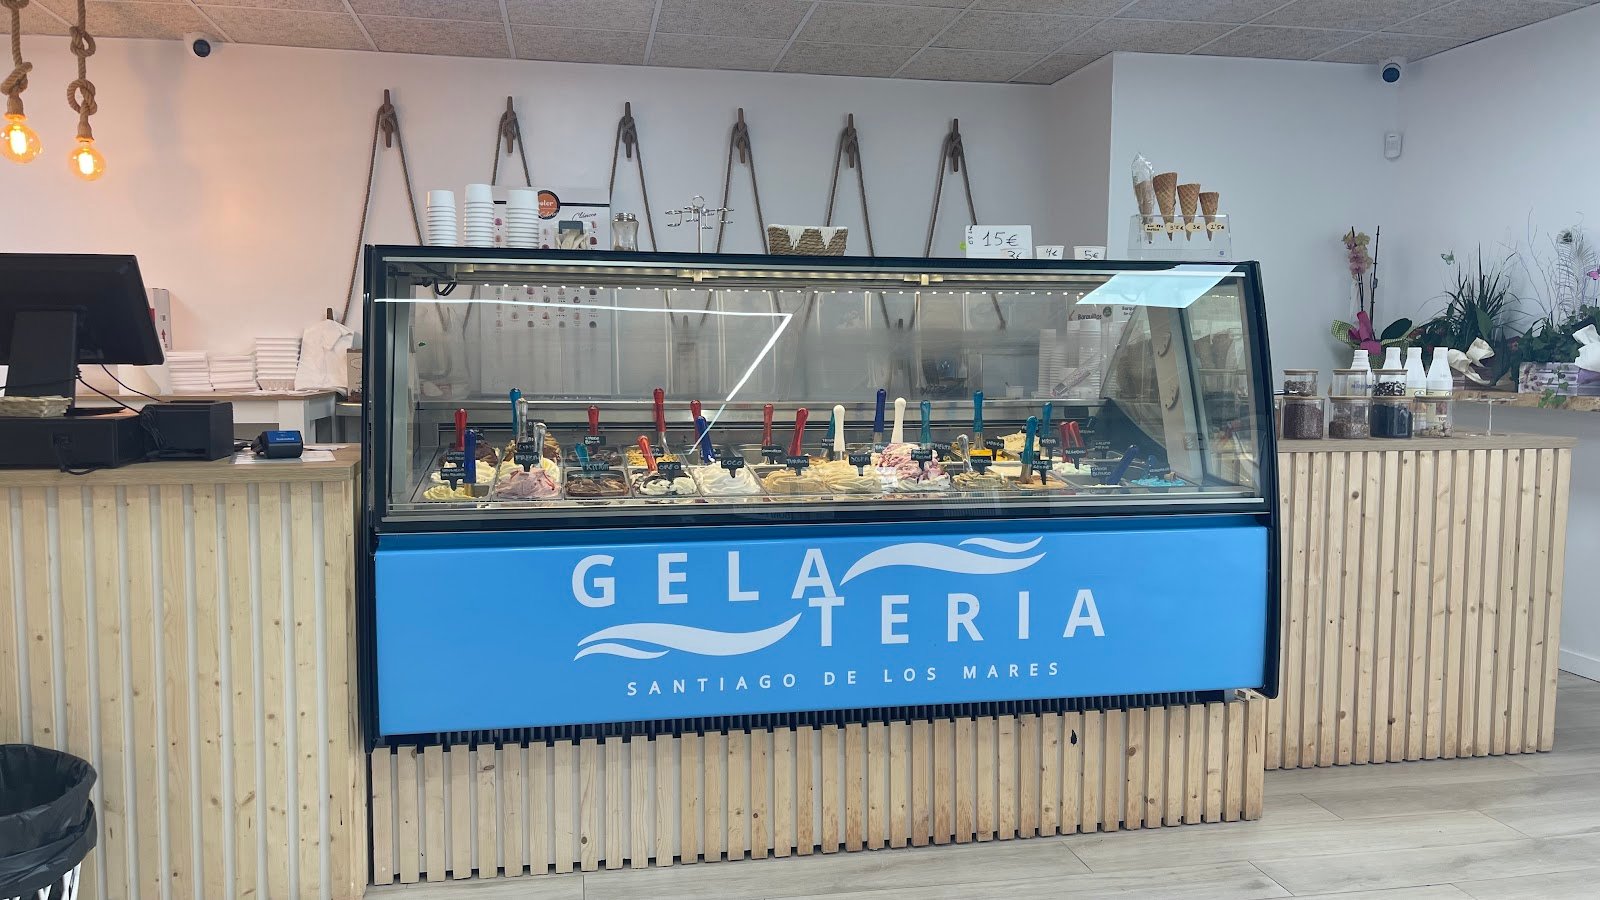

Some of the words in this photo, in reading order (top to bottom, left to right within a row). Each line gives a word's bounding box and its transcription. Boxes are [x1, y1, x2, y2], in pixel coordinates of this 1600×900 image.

[982, 230, 1020, 248] 15€
[1045, 248, 1058, 257] 4€
[1084, 250, 1099, 260] 5€
[627, 672, 797, 696] SANTIAGO
[824, 670, 857, 686] DE
[884, 667, 938, 684] LOS
[963, 662, 1060, 681] MARES
